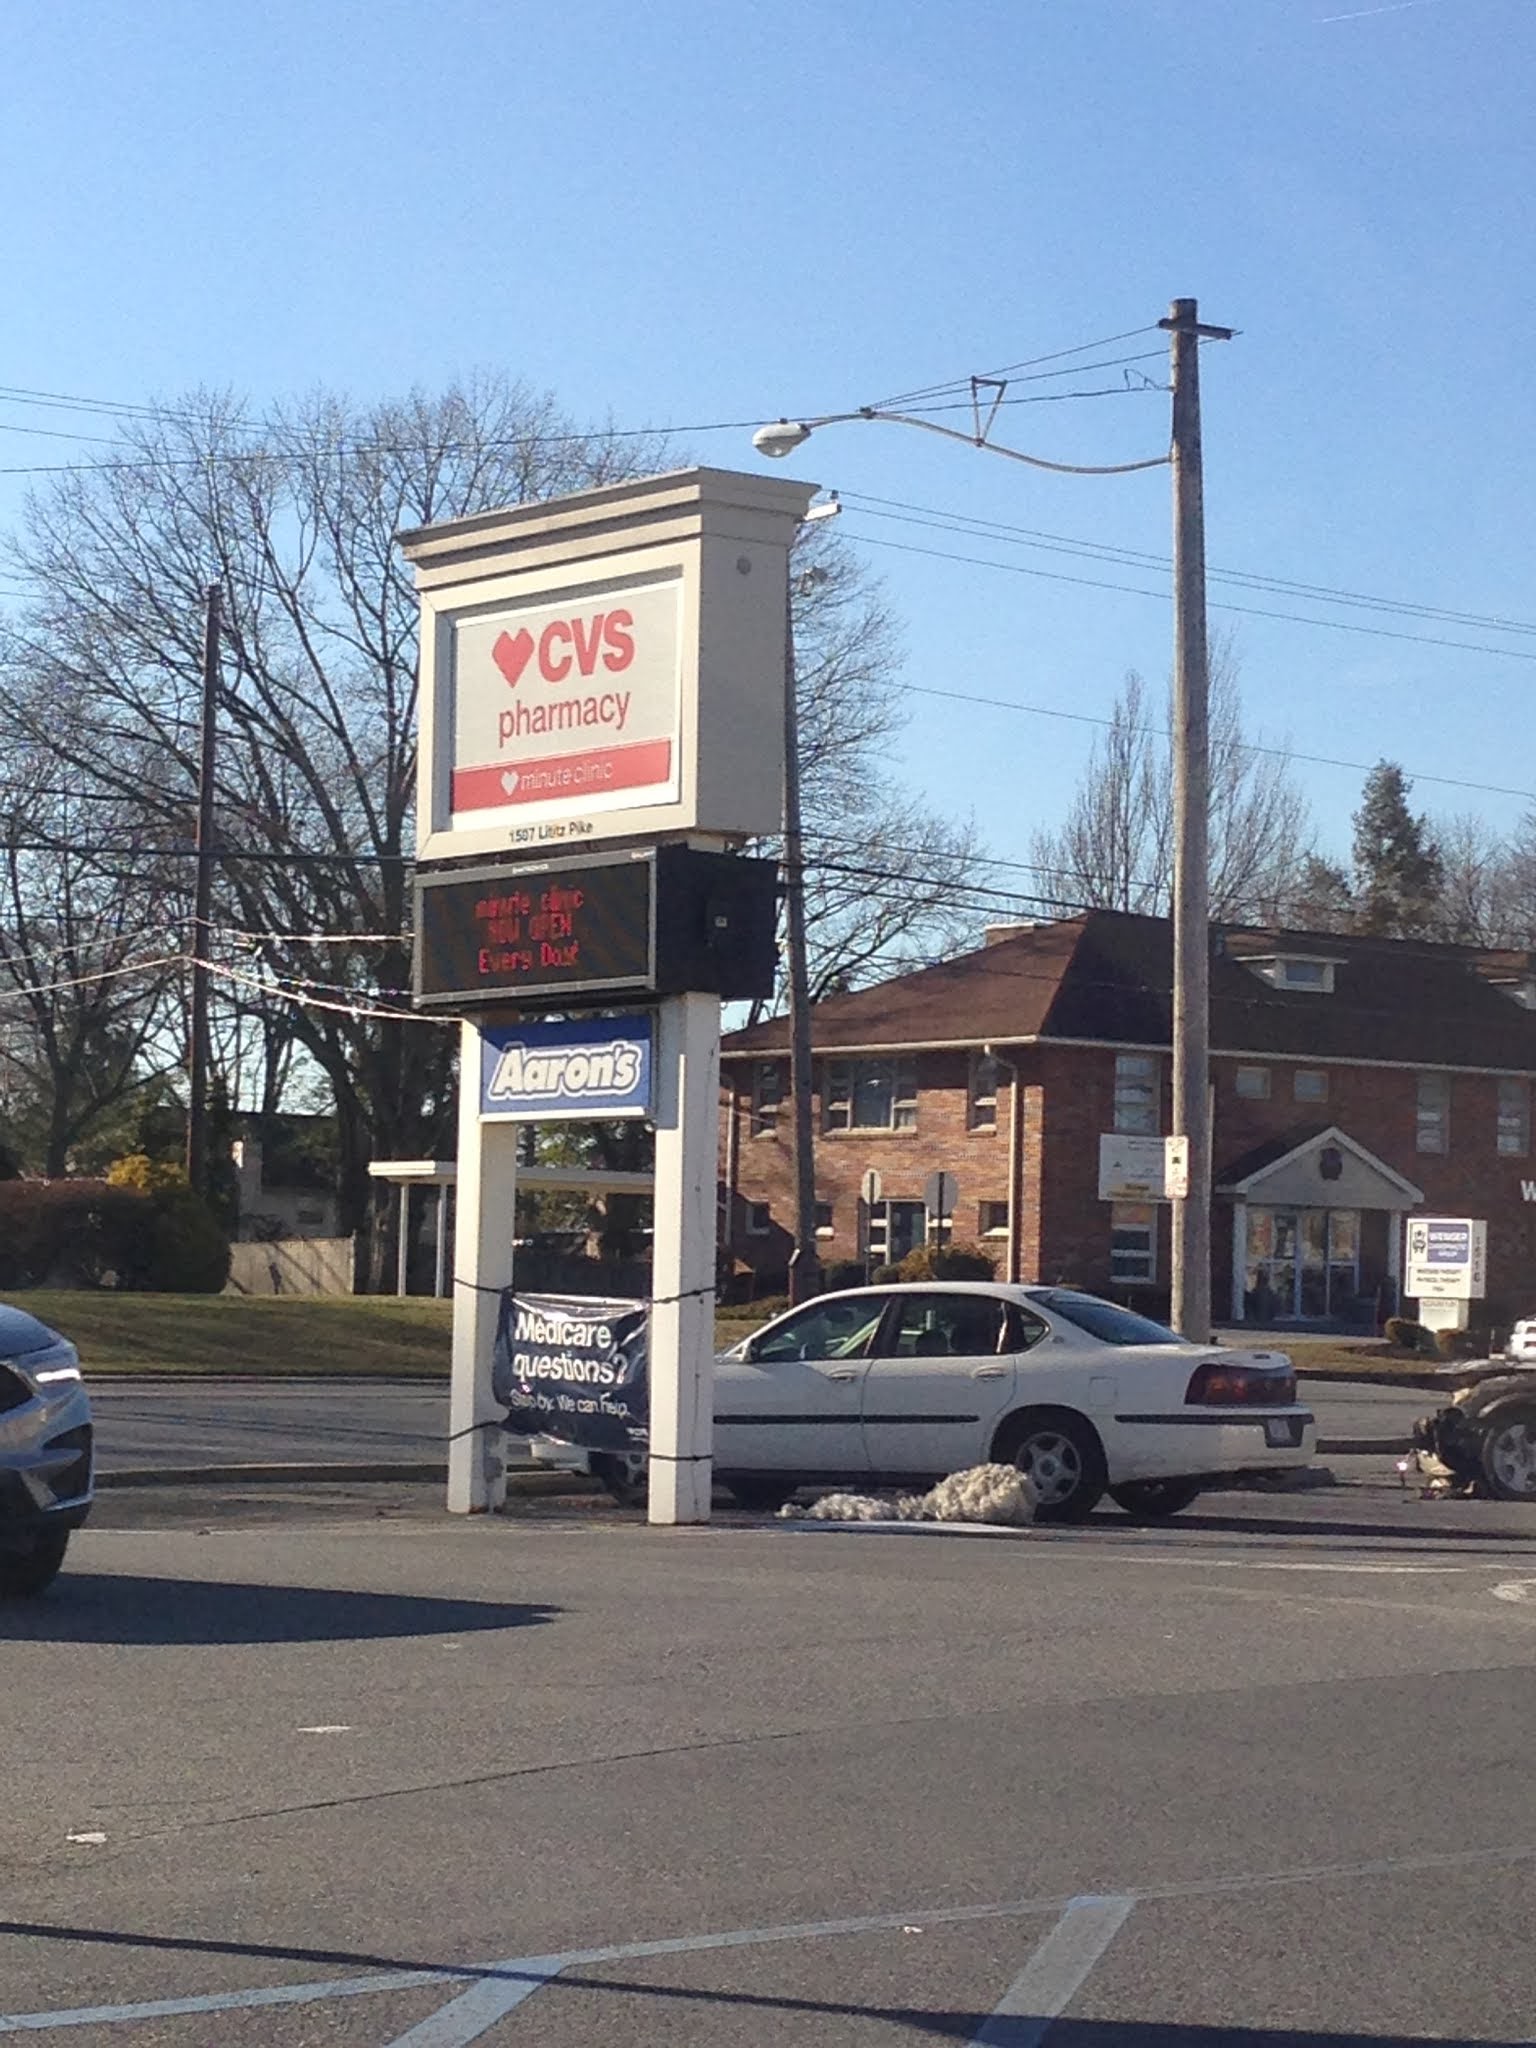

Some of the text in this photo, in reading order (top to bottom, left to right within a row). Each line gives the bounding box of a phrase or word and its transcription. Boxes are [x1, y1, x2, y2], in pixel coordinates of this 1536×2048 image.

[538, 608, 635, 683] CVS
[499, 691, 631, 749] pharmacy
[569, 820, 594, 836] Pike
[489, 1043, 641, 1100] Aaron's
[512, 1351, 628, 1385] questions?
[577, 1398, 599, 1414] can
